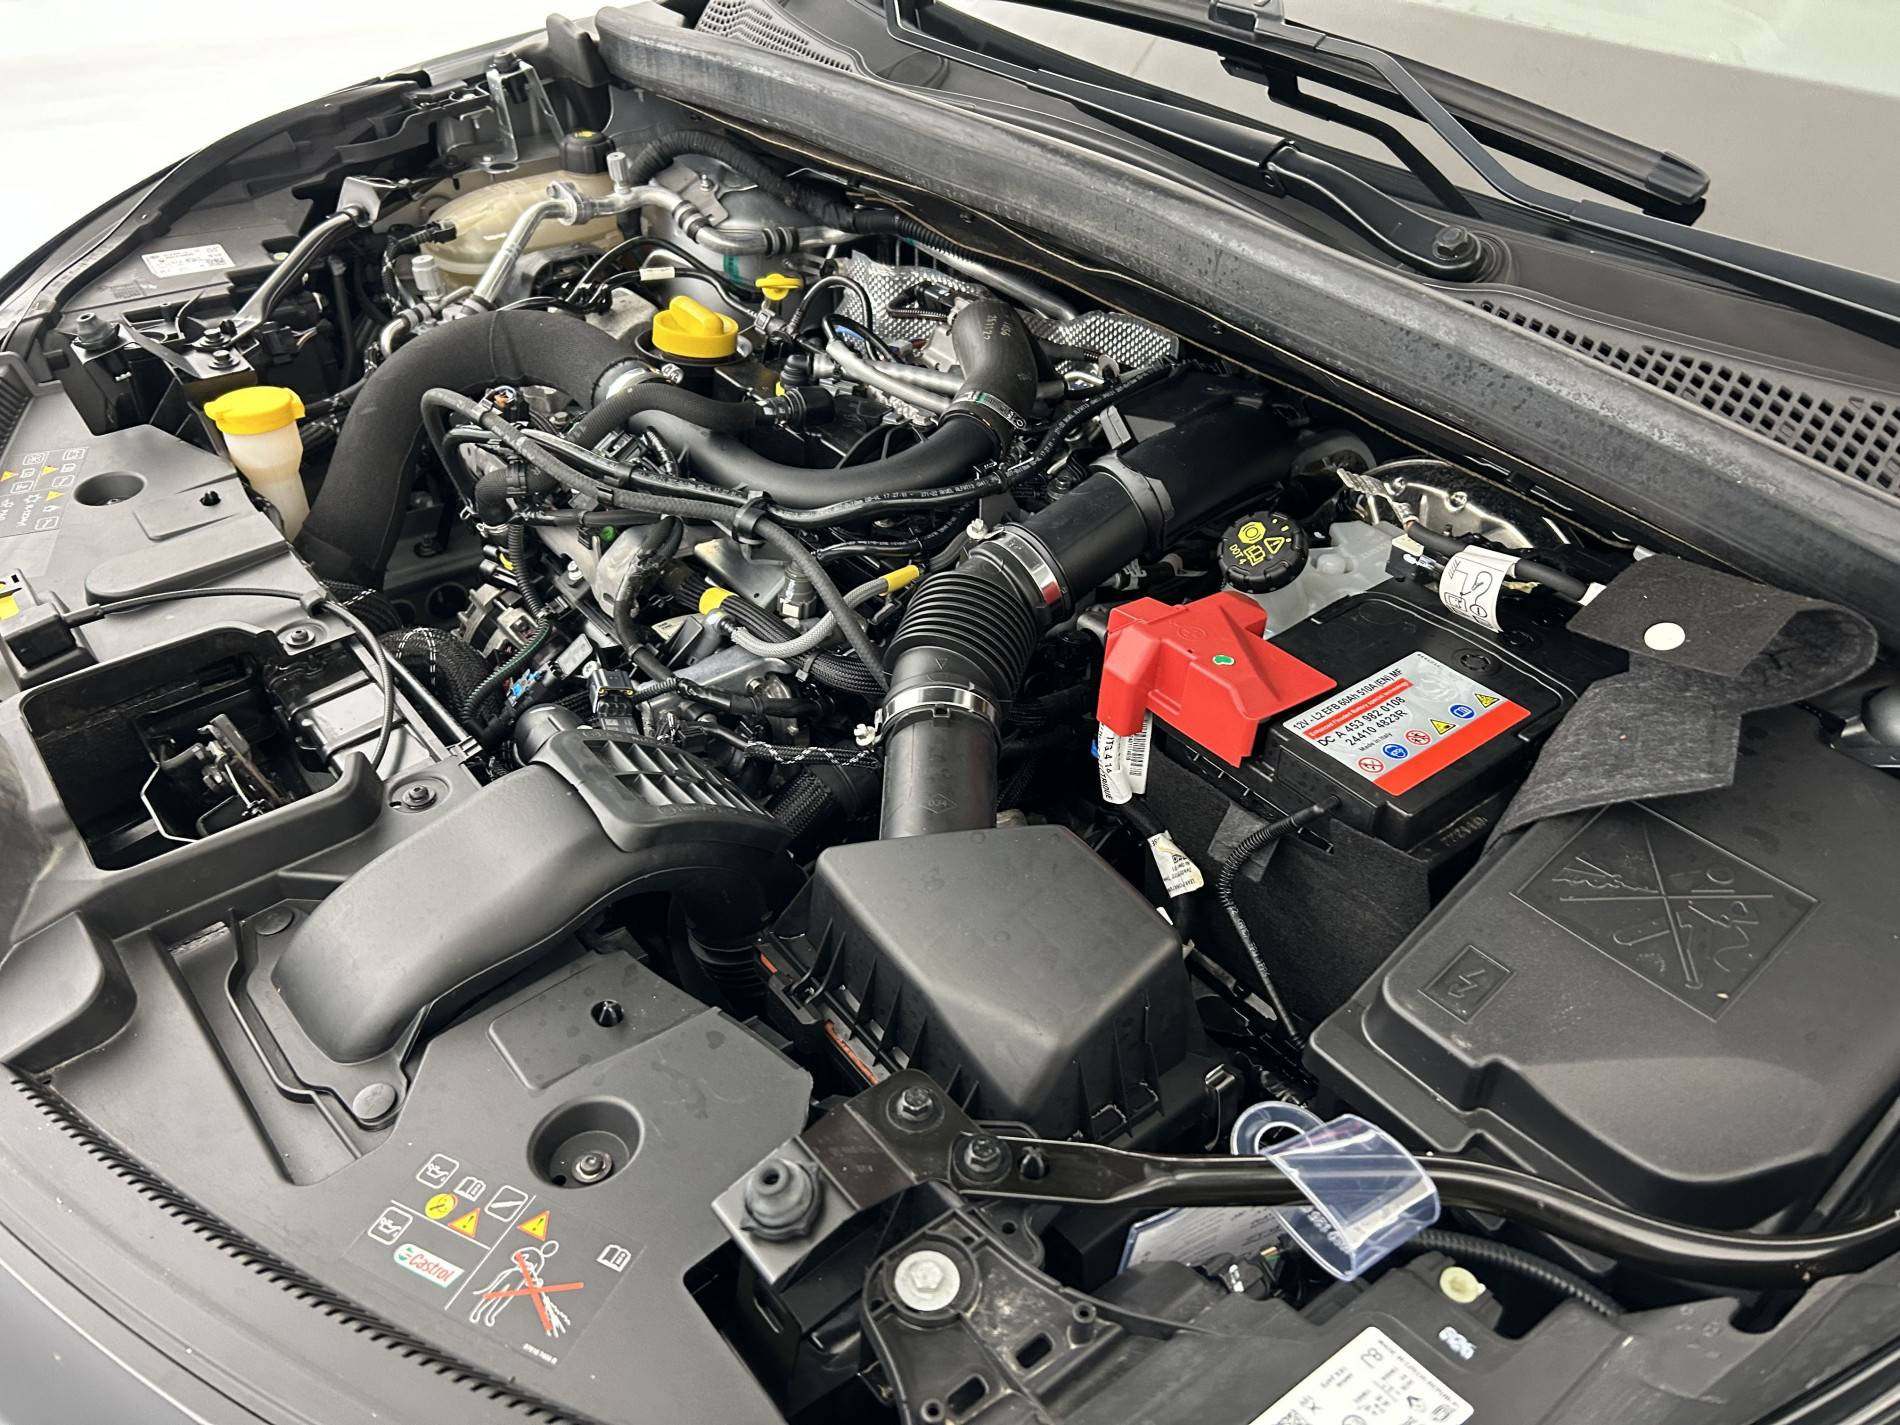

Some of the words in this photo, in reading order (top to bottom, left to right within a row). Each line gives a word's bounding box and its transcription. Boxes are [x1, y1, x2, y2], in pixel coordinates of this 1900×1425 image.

[1229, 544, 1244, 559] DOT
[1293, 718, 1310, 730] 12V
[1311, 711, 1325, 721] L2
[1321, 703, 1341, 715] EFB
[1337, 692, 1359, 706] 60Ah
[1356, 683, 1378, 696] 510A
[1374, 674, 1395, 689] (EN)
[1389, 668, 1403, 678] MF
[1317, 735, 1336, 747] DC
[1335, 730, 1346, 740] A
[1344, 719, 1364, 733] 453
[1362, 709, 1383, 722] 982
[1380, 696, 1406, 712] 0108
[1345, 726, 1377, 746] 24410
[1376, 709, 1408, 729] 4823R
[408, 1253, 455, 1282] Castrol
